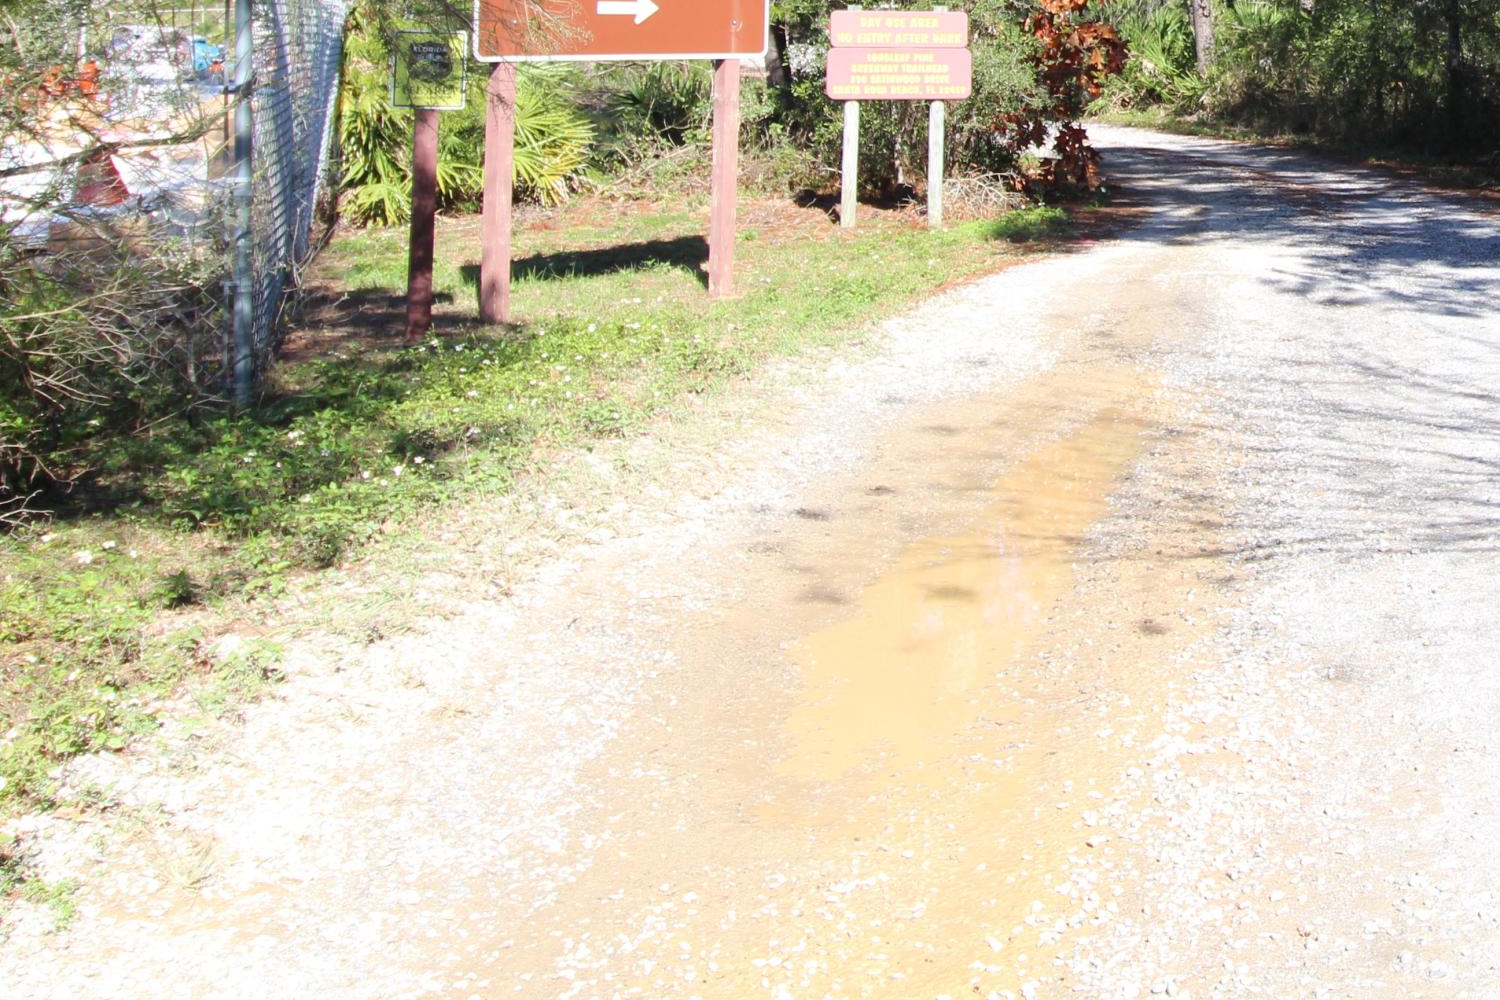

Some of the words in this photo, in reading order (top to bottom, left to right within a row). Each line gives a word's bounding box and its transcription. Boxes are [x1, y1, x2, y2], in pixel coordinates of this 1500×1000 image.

[860, 17, 881, 28] DAY
[885, 17, 906, 28] USE
[909, 17, 939, 28] AREA
[836, 32, 853, 43] NO
[856, 32, 892, 44] ENTRY
[895, 32, 929, 44] AFTER
[932, 33, 962, 44] DARK
[866, 53, 910, 62] LONGLEAF
[912, 53, 934, 62] PINE
[851, 63, 899, 73] GREENWAY
[901, 63, 950, 73] TRAILHEAD
